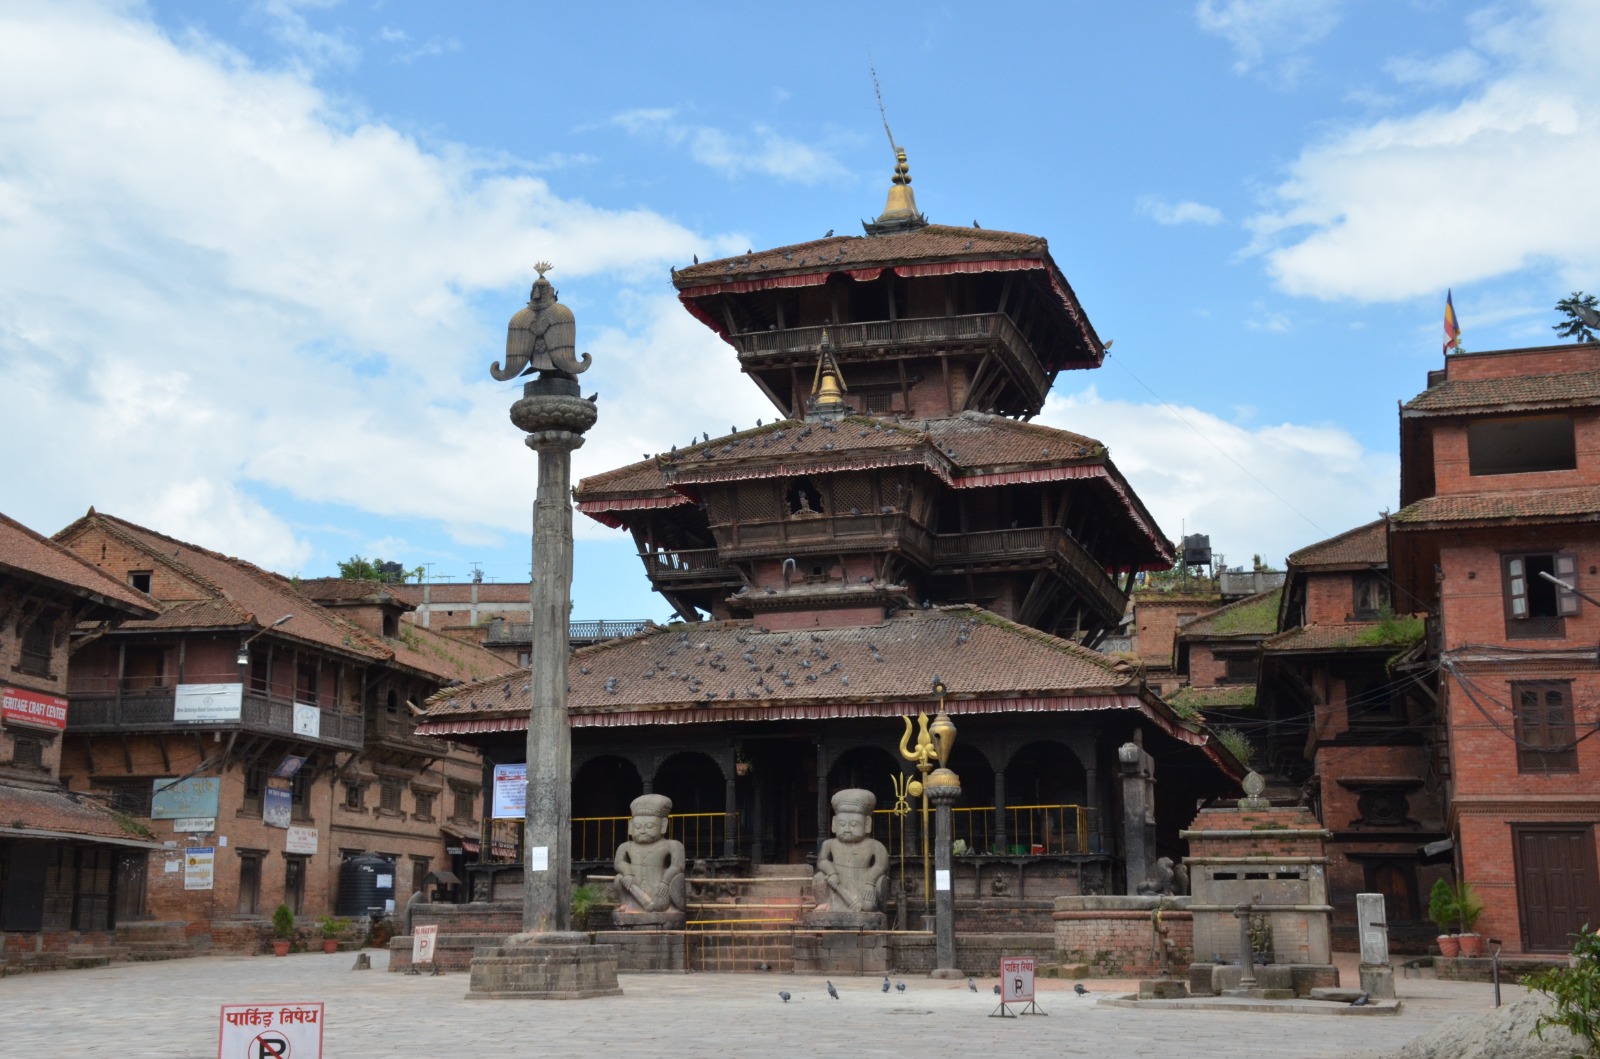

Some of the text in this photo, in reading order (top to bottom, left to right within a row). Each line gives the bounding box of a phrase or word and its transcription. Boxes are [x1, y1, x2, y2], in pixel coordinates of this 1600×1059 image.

[29, 701, 46, 716] CRAFT
[46, 705, 66, 720] CENTER
[279, 1007, 318, 1025] निषेध
